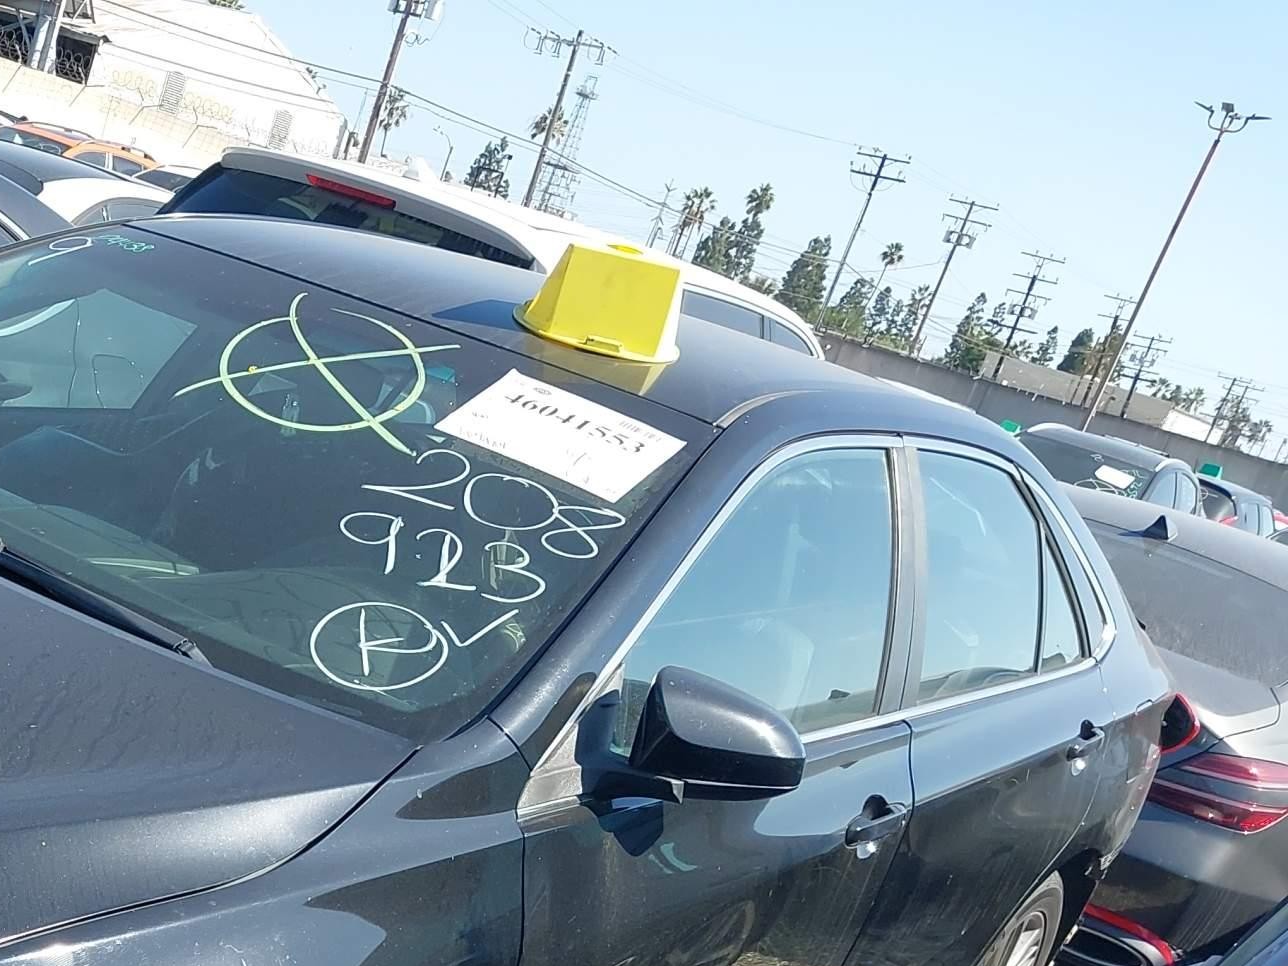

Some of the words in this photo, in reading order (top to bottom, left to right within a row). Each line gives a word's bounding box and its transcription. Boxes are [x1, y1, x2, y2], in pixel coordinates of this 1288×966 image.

[503, 393, 646, 454] 46041553
[361, 448, 626, 559] 208
[339, 511, 546, 602] 923
